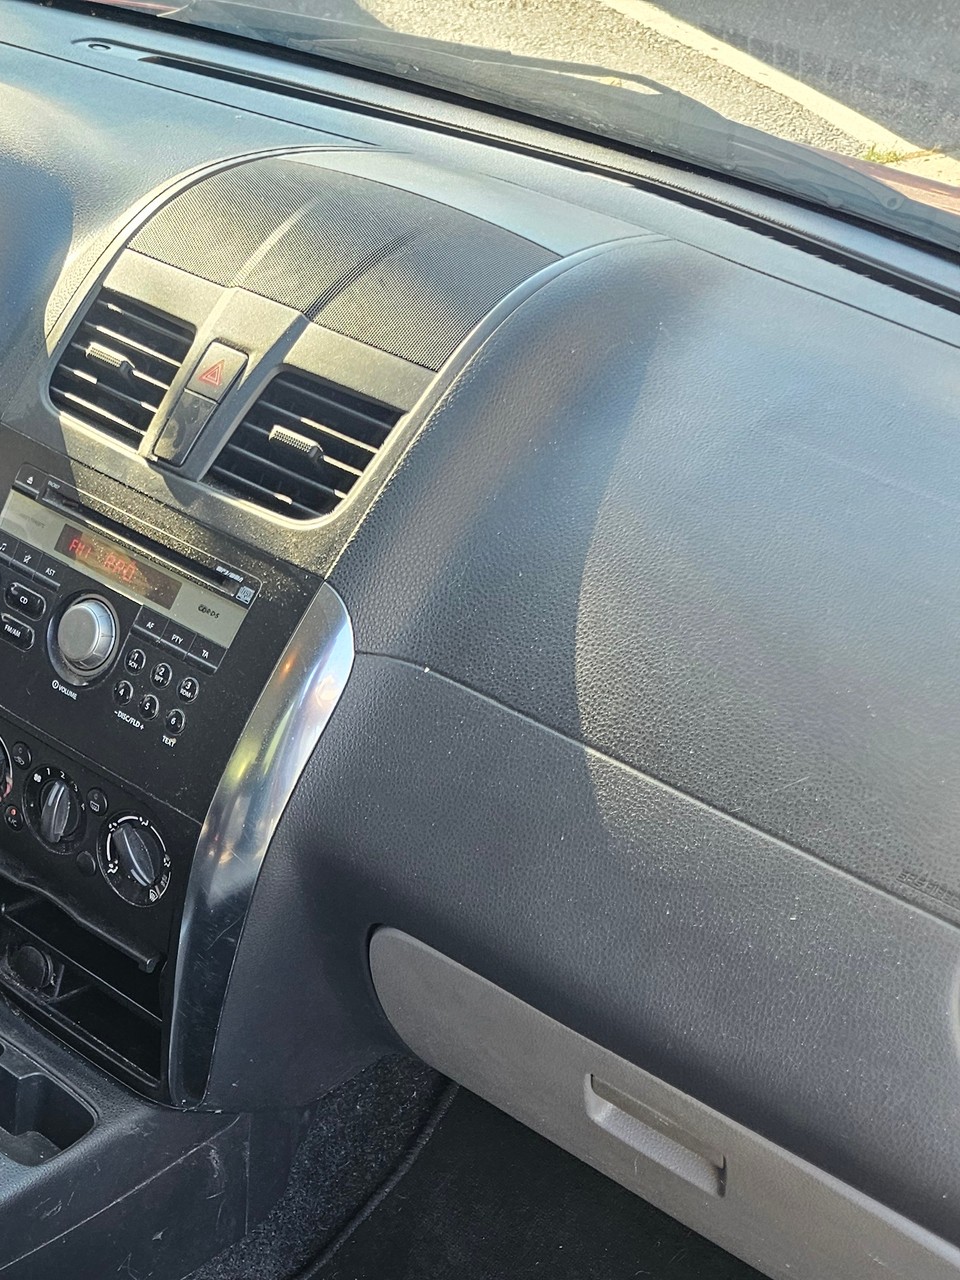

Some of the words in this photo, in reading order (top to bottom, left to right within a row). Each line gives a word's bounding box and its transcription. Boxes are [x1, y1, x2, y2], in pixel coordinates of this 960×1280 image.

[45, 567, 56, 577] AST
[19, 595, 28, 605] CD
[146, 621, 155, 630] AF
[4, 624, 21, 638] FM/AM
[171, 634, 184, 645] PTY
[133, 653, 139, 661] 1
[201, 649, 210, 659] TA
[158, 667, 166, 676] 2
[185, 681, 192, 690] 3
[57, 685, 78, 700] VOLUME
[118, 688, 125, 696] 4
[144, 702, 151, 711] 5
[170, 717, 177, 725] 6
[162, 735, 176, 748] TEXT
[46, 767, 51, 776] 1
[60, 771, 66, 780] 2
